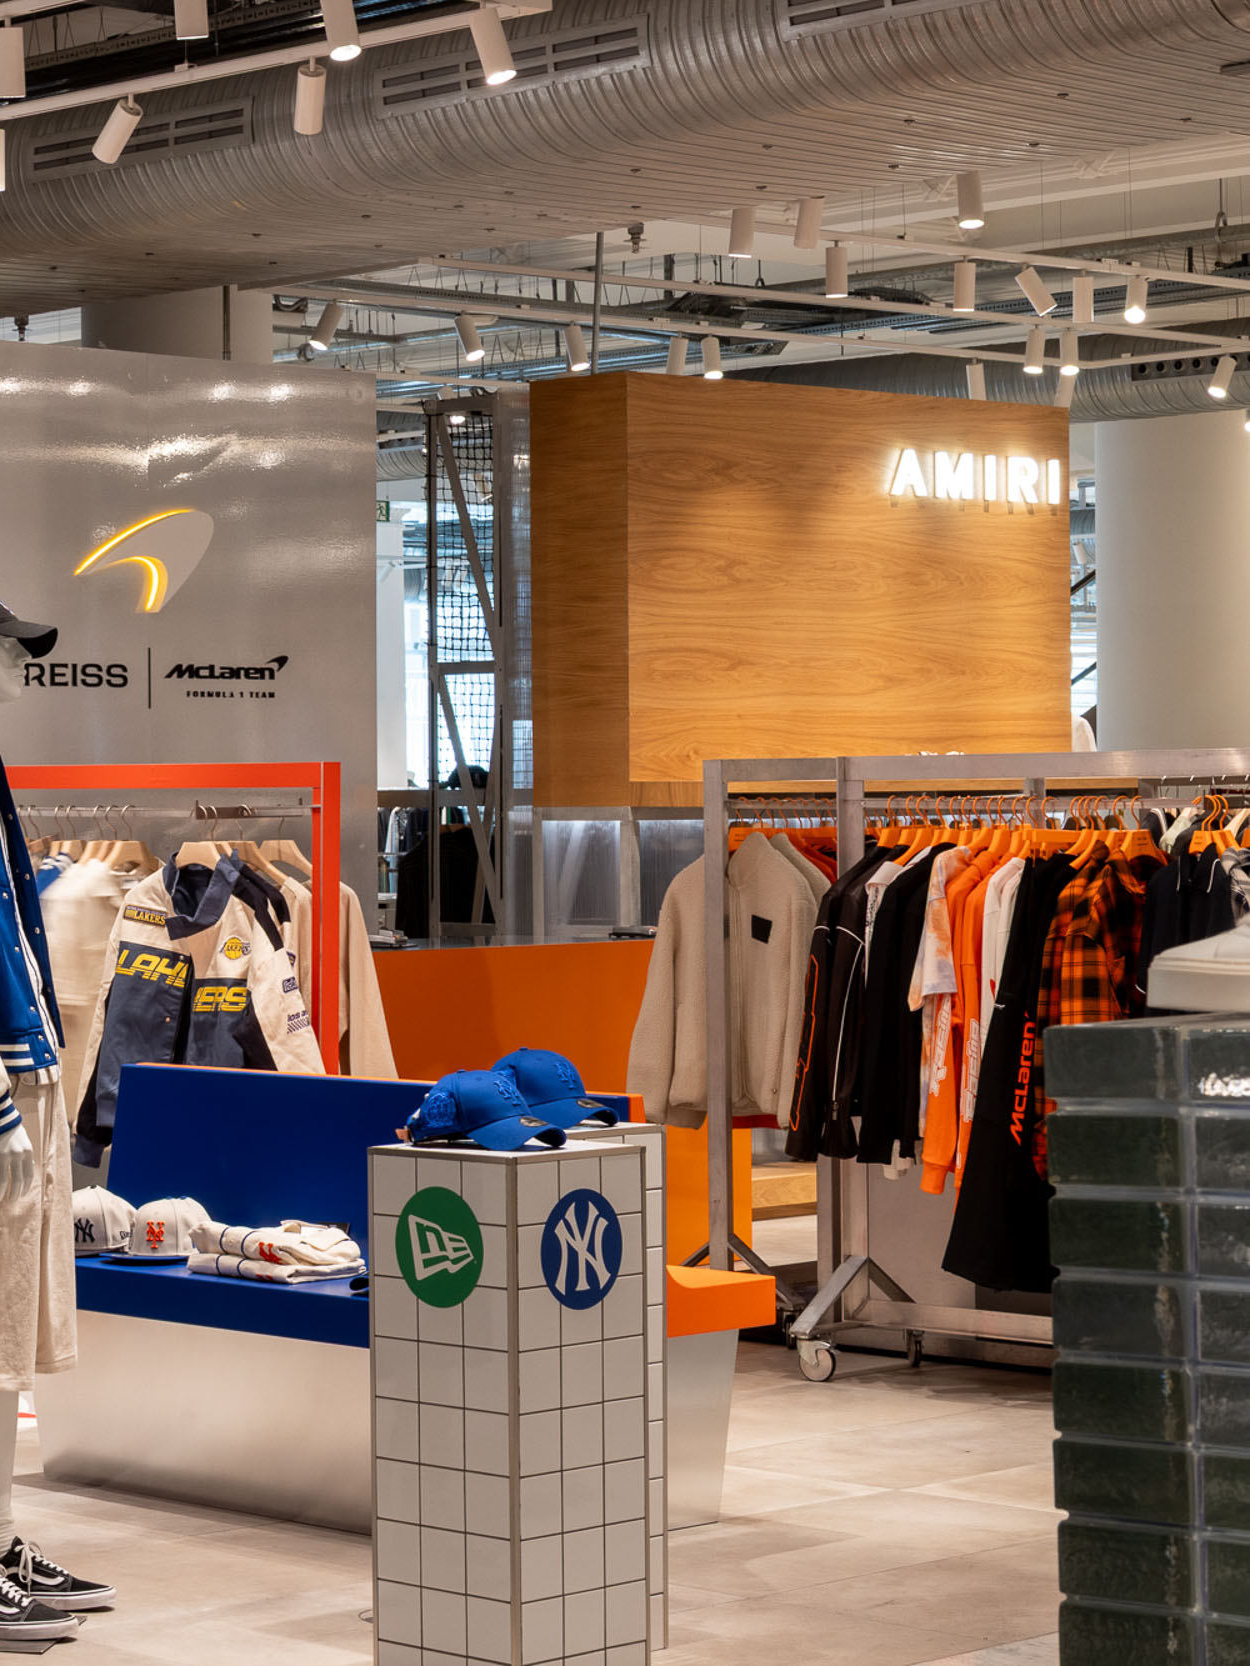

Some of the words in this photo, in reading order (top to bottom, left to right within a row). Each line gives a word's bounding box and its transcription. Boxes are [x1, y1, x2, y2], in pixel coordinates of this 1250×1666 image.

[890, 448, 1060, 505] AMIRI
[24, 663, 128, 688] REISS
[164, 660, 280, 680] McLaren
[134, 910, 166, 926] LAKERS
[1009, 1019, 1037, 1146] McLaren
[554, 1201, 611, 1296] NY
